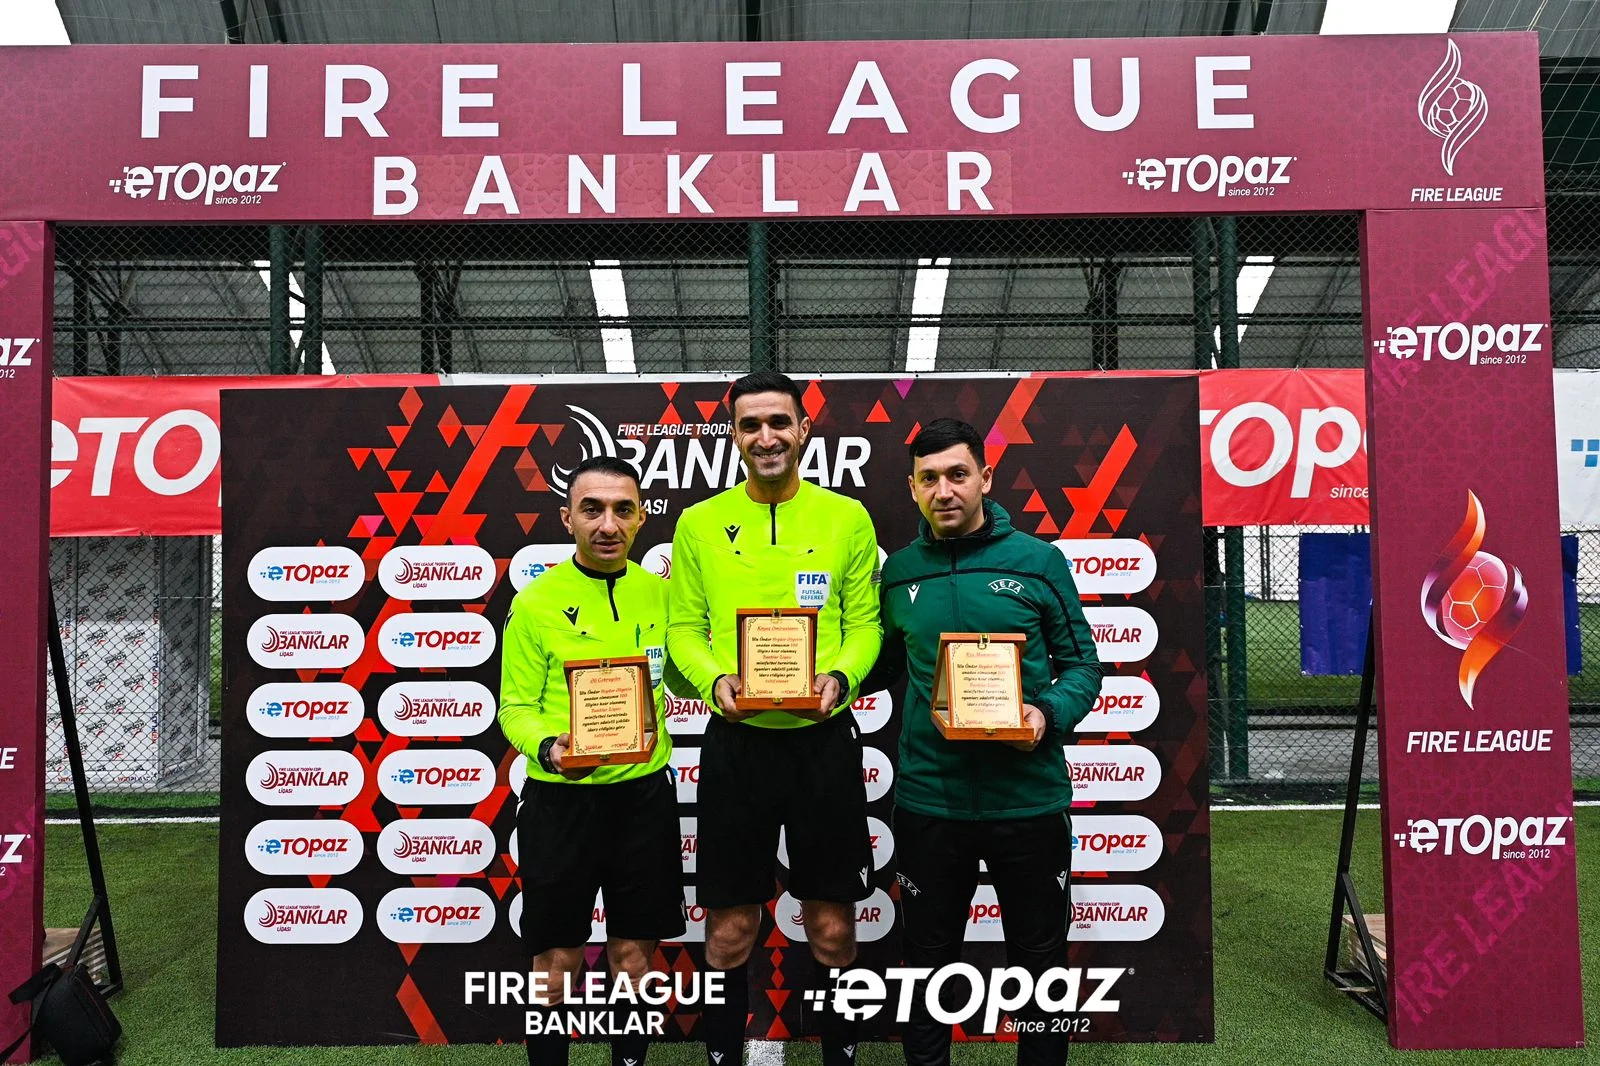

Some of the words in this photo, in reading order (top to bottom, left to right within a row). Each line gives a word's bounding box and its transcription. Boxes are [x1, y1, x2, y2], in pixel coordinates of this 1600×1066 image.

[141, 64, 499, 138] FIRE
[622, 55, 1255, 136] LEAGUE
[373, 151, 994, 216] BANKLAR
[1228, 187, 1250, 196] since
[1254, 186, 1275, 196] 2012
[215, 195, 238, 204] since
[240, 195, 262, 204] 2012
[1410, 188, 1442, 202] FIRE
[1446, 187, 1503, 202] LEAGUE
[1480, 355, 1502, 365] since
[1505, 354, 1527, 364] 2012
[617, 424, 644, 436] FIRE
[646, 423, 693, 436] LEAGUE
[411, 566, 482, 581] BANKLAR
[798, 574, 827, 584] FIFA
[991, 579, 1022, 593] UEFA
[278, 635, 349, 650] BANKLAR
[646, 648, 662, 659] FIFA
[411, 702, 482, 717] BANKLAR
[1406, 731, 1459, 752] FIRE
[1464, 730, 1553, 752] LEAGUE
[277, 772, 349, 786] BANKLAR
[1072, 766, 1144, 781] BANKLAR
[410, 840, 482, 855] BANKLAR
[1502, 849, 1526, 859] since
[1528, 848, 1550, 858] 2012
[275, 909, 348, 924] BANKLAR
[1075, 906, 1148, 921] BANKLAR
